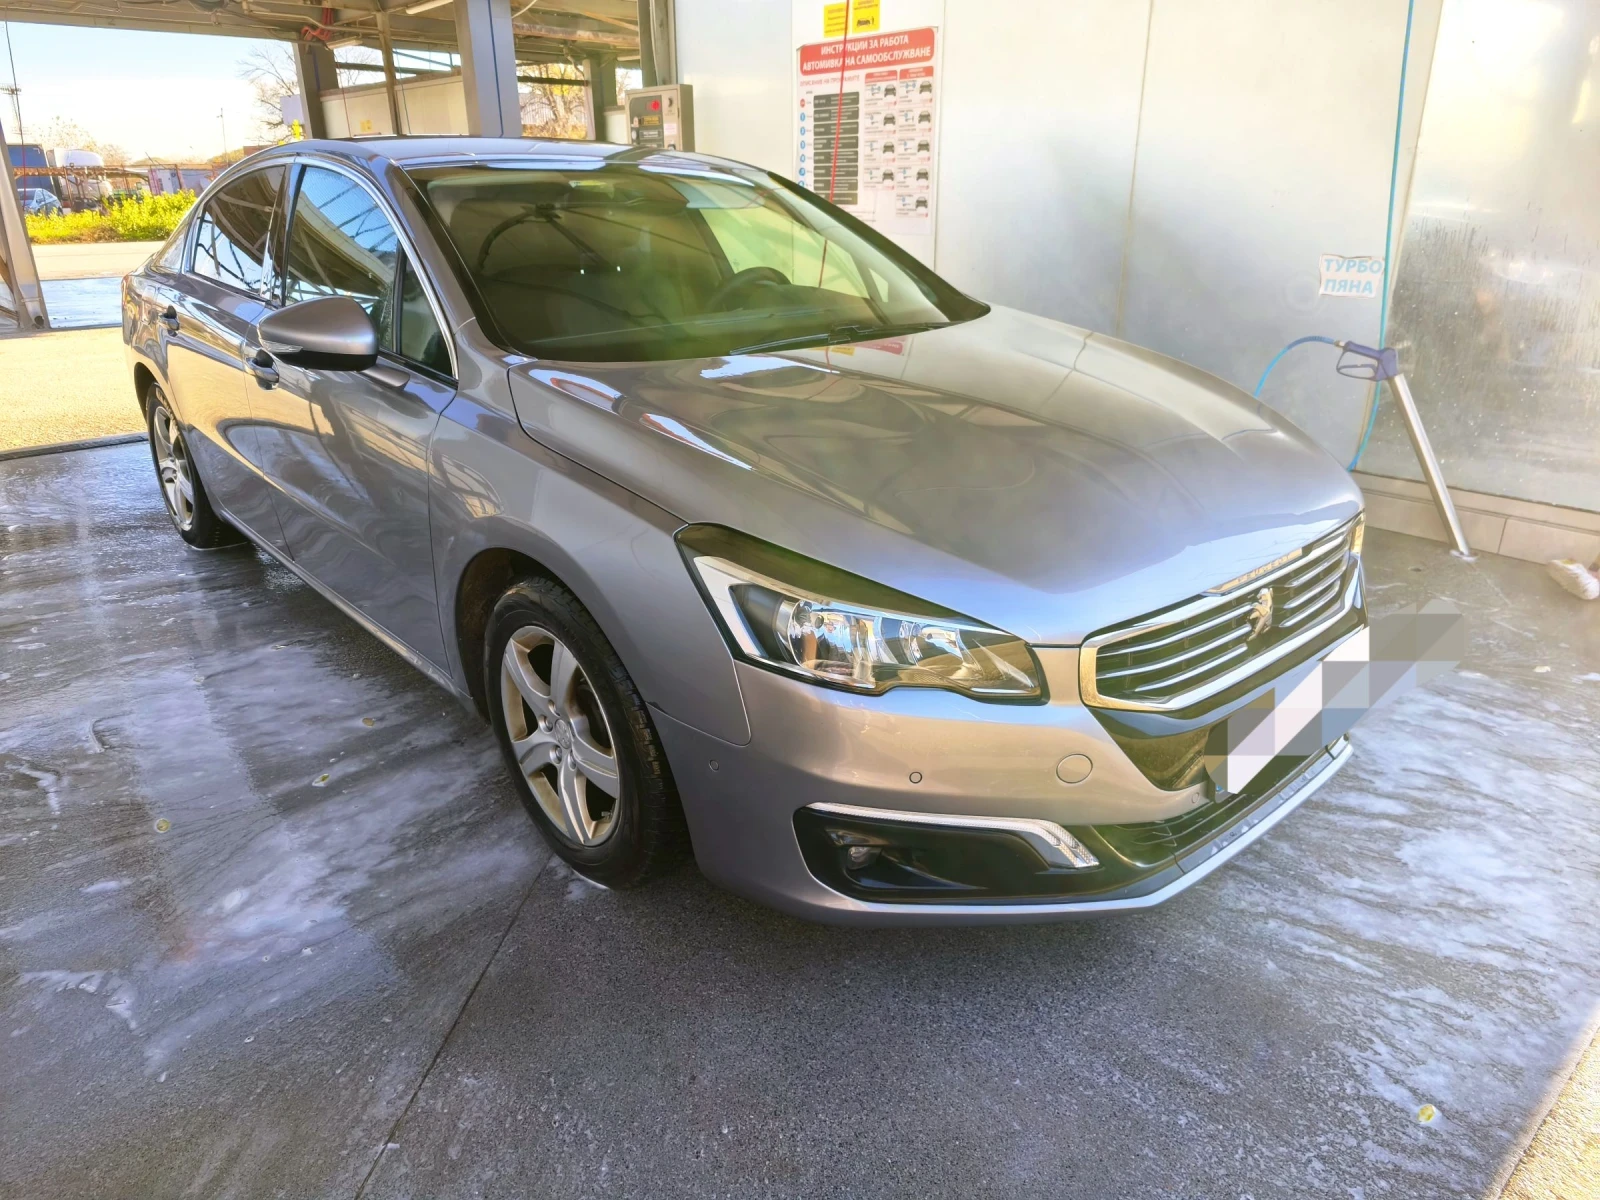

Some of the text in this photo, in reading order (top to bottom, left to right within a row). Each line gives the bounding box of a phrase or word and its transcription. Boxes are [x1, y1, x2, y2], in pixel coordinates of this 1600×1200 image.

[869, 39, 879, 49] ЗА
[880, 35, 909, 48] РАБОТА
[845, 56, 855, 66] НА
[856, 46, 931, 65] САМООБСЛУЖВАНЕ
[1324, 258, 1383, 274] ТУРБО
[1324, 278, 1374, 294] ПЯНА
